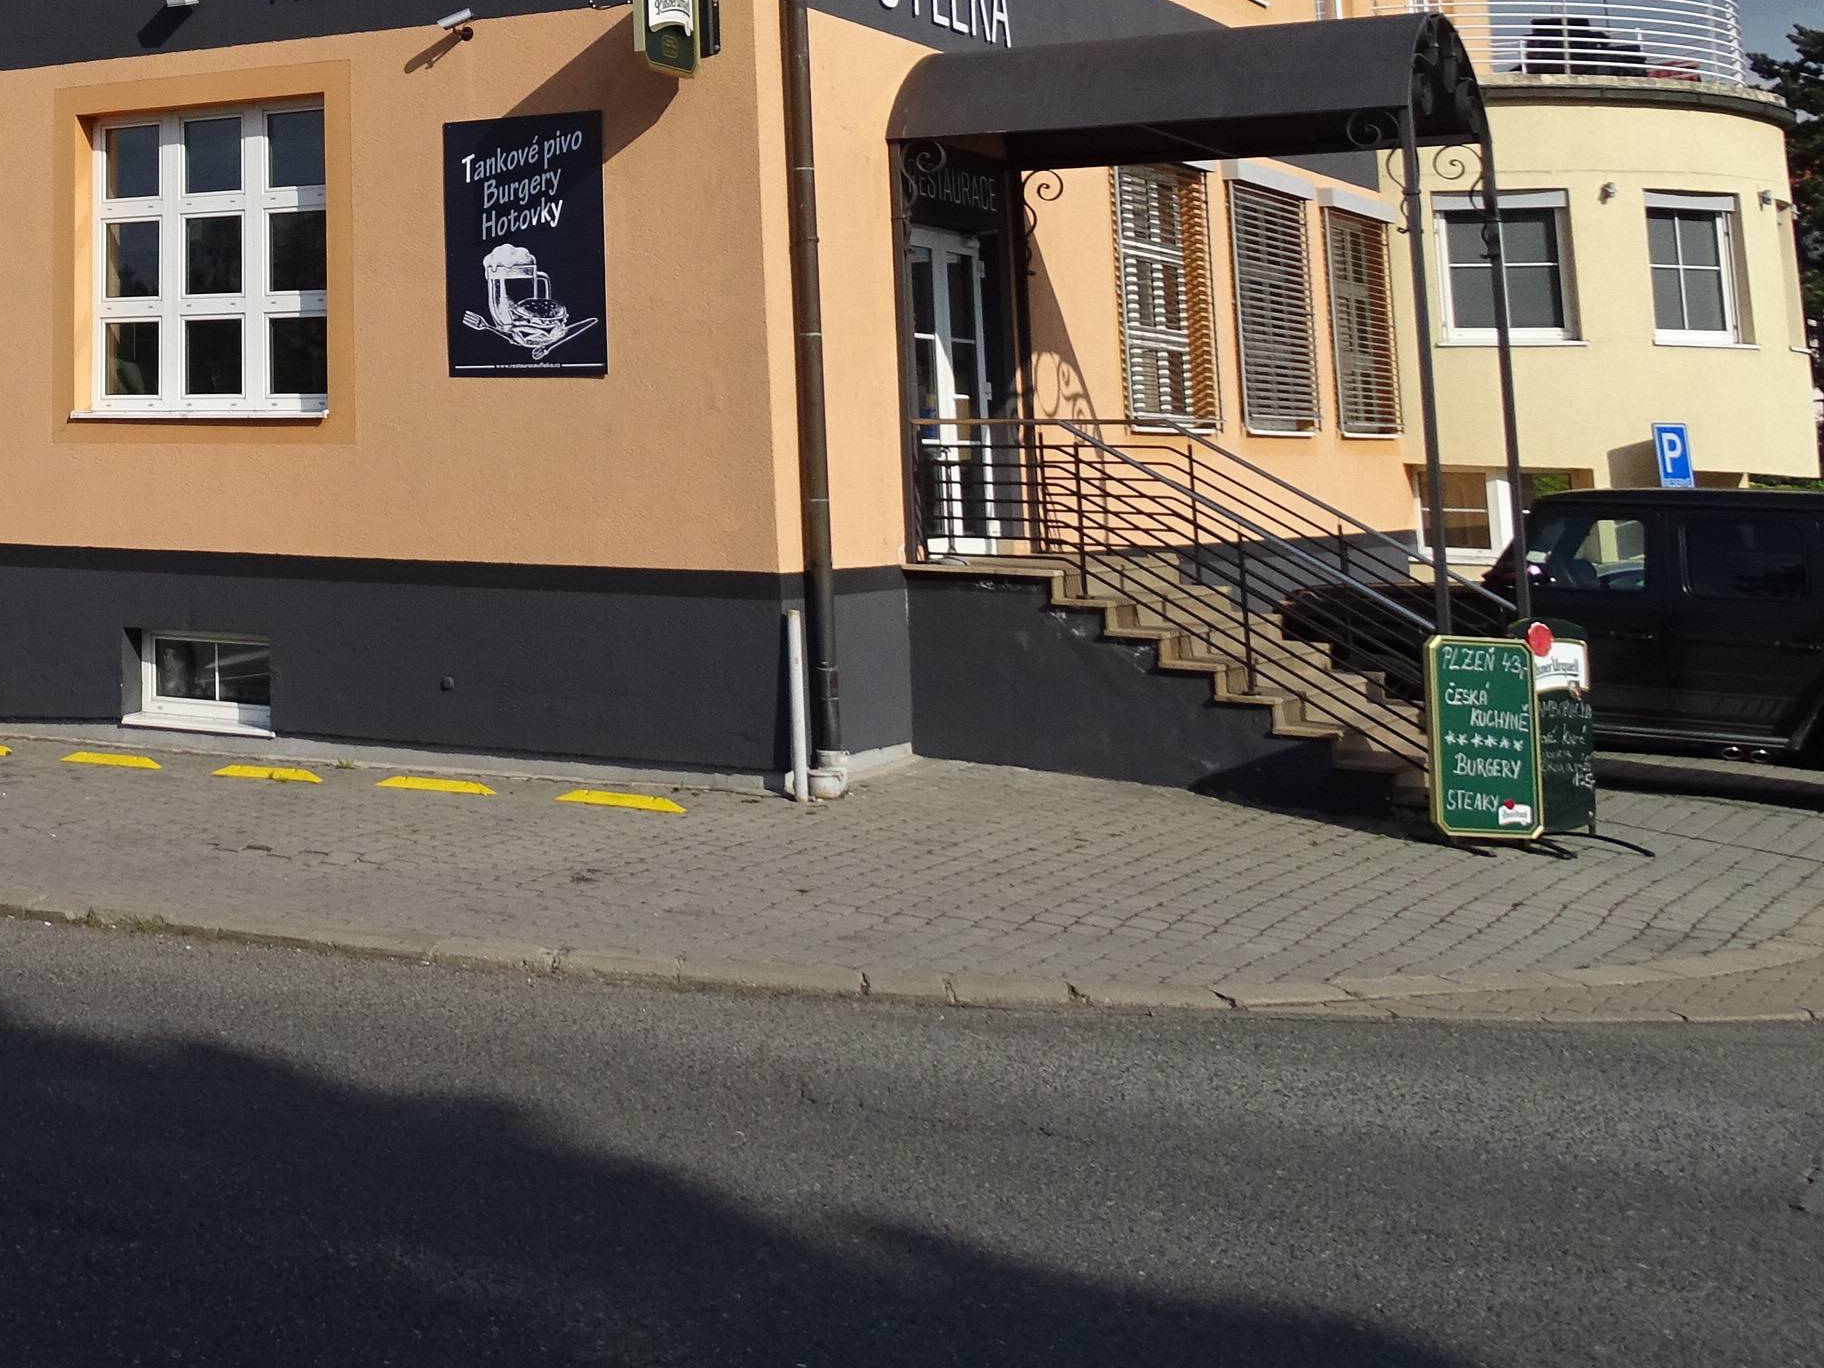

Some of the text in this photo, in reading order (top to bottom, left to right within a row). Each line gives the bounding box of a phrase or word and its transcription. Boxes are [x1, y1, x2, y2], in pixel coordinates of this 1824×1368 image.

[462, 130, 583, 183] Tankové pivo
[483, 169, 562, 209] Burgery
[482, 197, 563, 240] Hotovky
[1662, 432, 1681, 473] P
[1442, 646, 1495, 671] PLZEŇ
[1445, 682, 1490, 706] ČESKÁ
[1470, 703, 1529, 732] KUCHYNĚ
[1453, 752, 1521, 779] BURGERY
[1446, 789, 1500, 812] STEAKY
